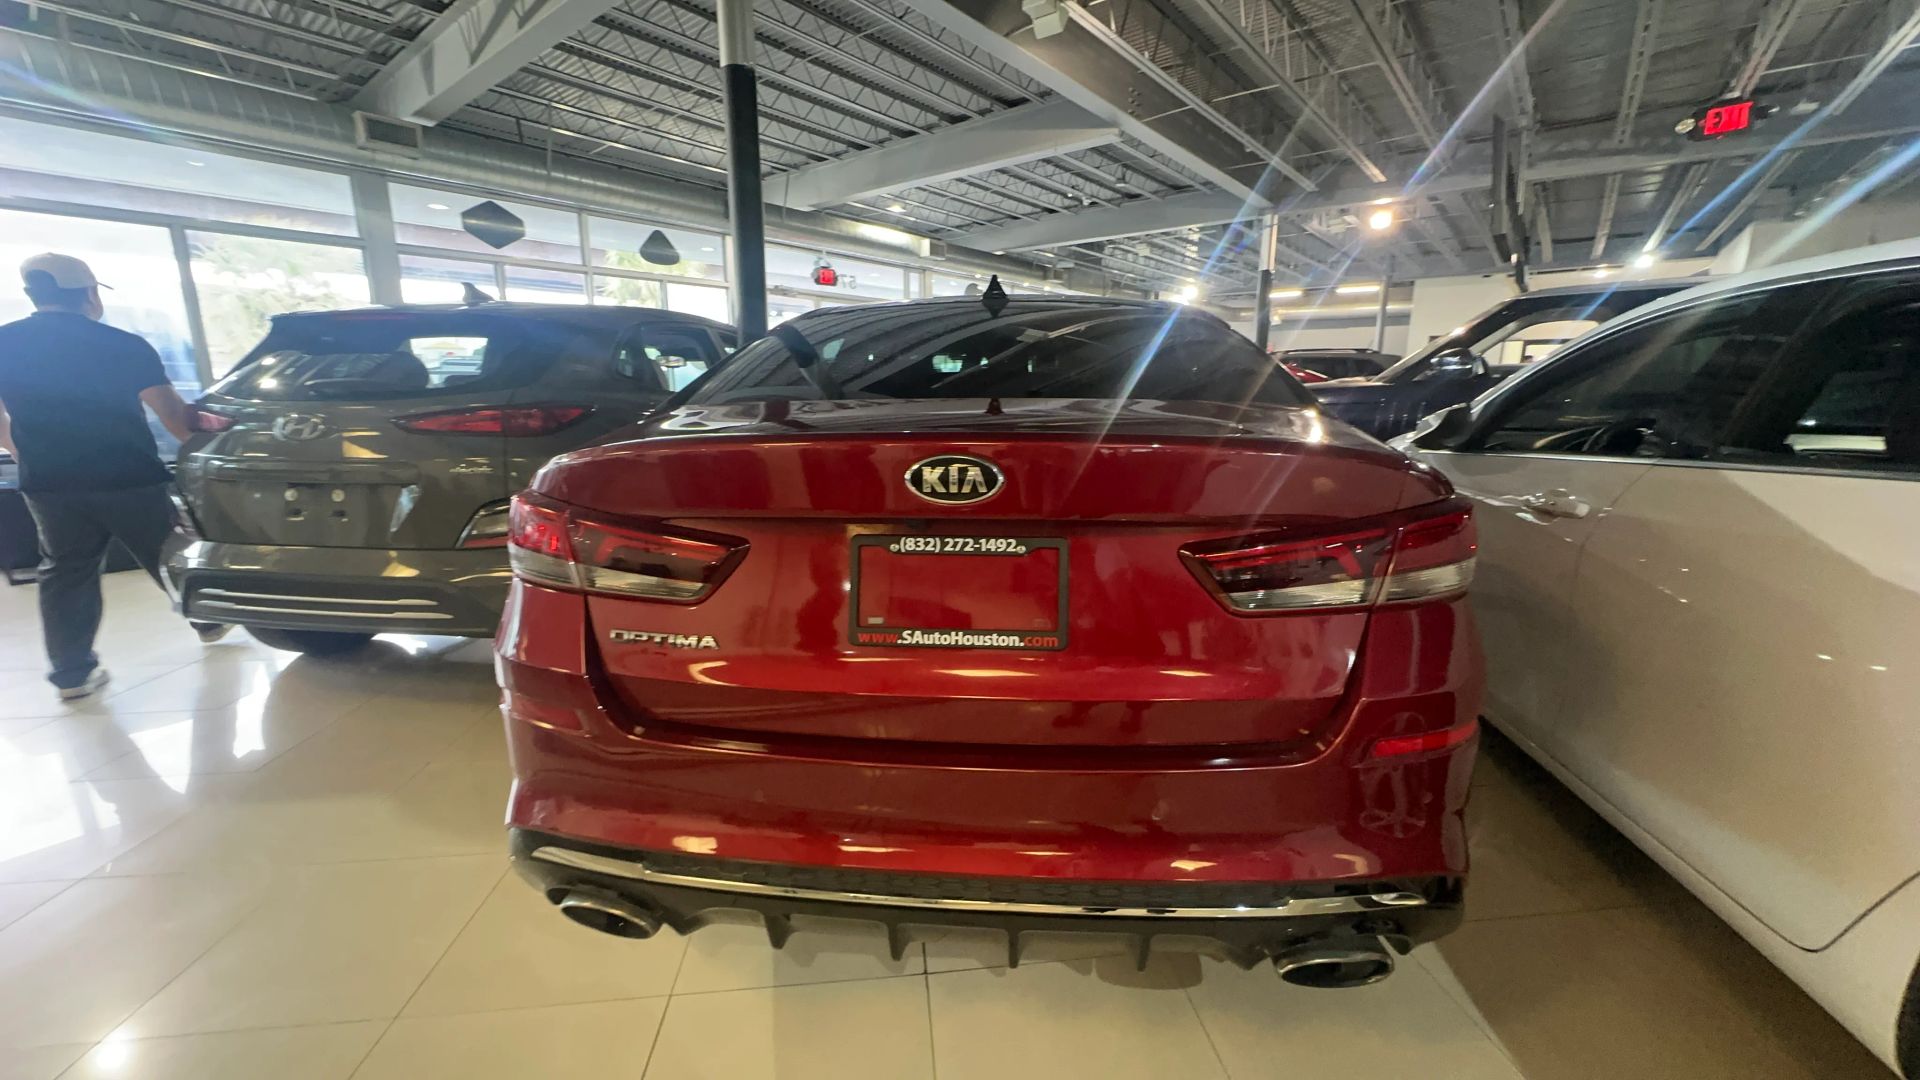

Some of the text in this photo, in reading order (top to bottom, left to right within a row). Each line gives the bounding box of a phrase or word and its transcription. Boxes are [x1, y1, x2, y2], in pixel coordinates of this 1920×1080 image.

[921, 464, 988, 493] KIA
[899, 537, 1017, 553] (832) 272-1492
[609, 629, 720, 650] OPTIMA
[857, 630, 1059, 648] www.SAutoHouston.com
